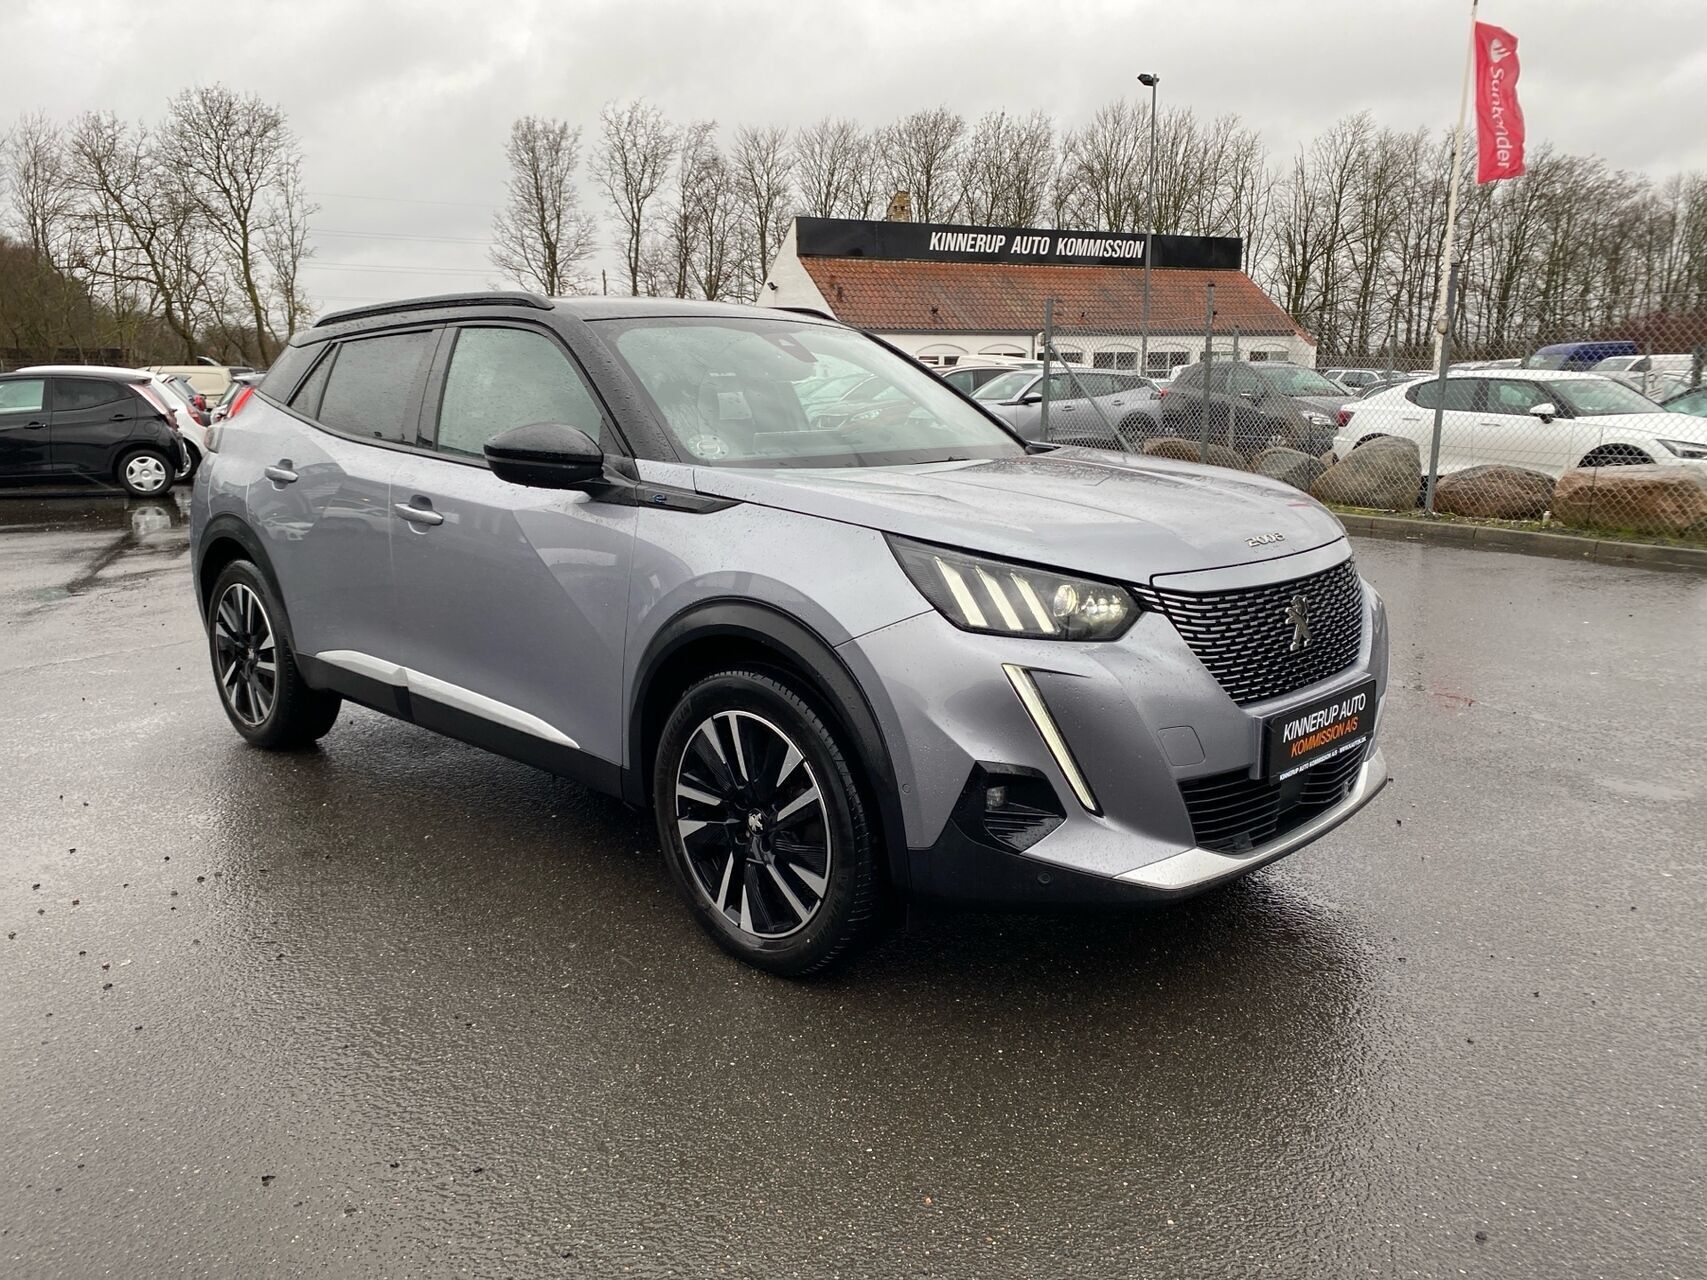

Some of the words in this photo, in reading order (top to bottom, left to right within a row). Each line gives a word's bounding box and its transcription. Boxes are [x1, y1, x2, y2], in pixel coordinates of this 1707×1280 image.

[929, 231, 1005, 254] KINNERUP
[1011, 235, 1051, 256] AUTO
[1056, 237, 1144, 260] KOMMISSION
[1245, 532, 1285, 547] 2008
[1282, 704, 1339, 743] KINNERUP
[1339, 692, 1366, 720] AUTO
[1290, 723, 1346, 758] KOMMISSION
